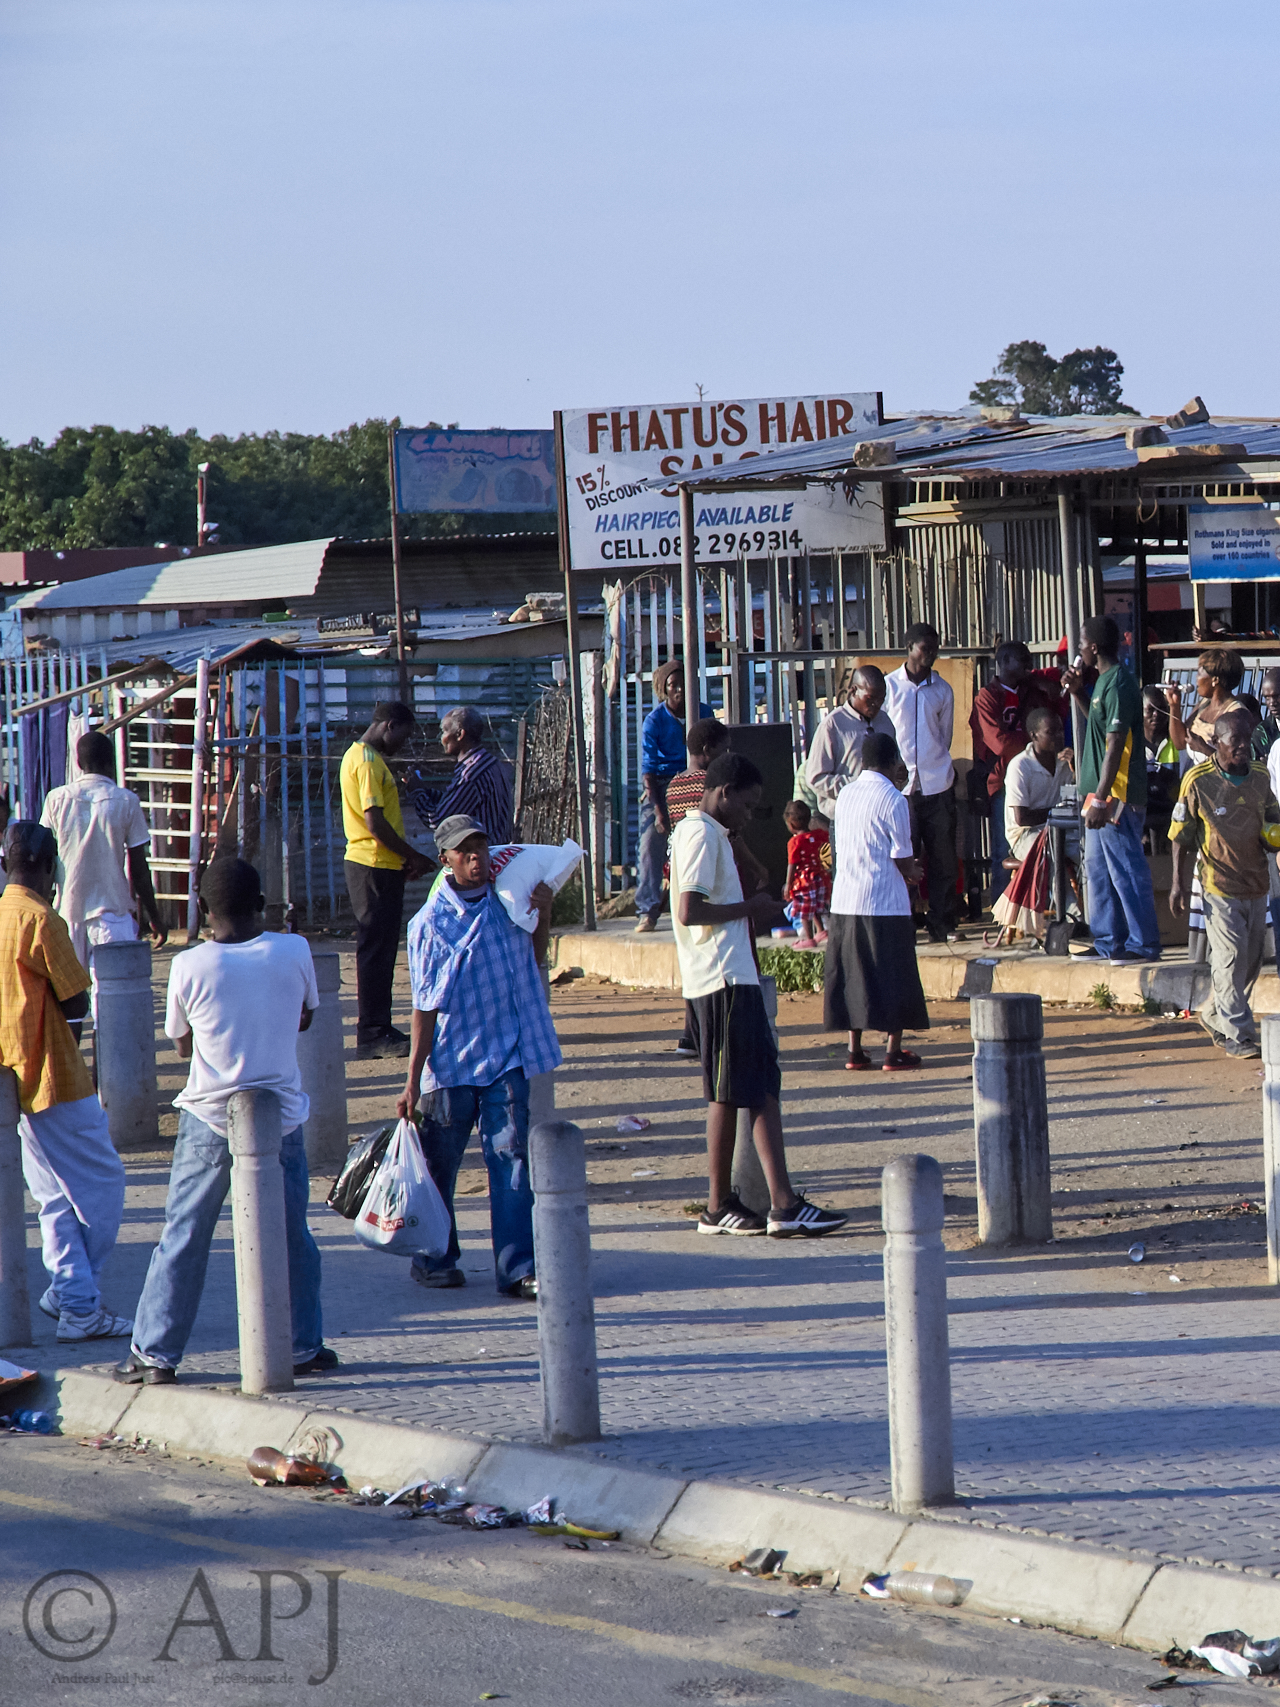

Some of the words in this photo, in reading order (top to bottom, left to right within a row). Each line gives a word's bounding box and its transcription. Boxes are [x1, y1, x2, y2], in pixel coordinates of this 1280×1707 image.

[587, 403, 747, 453] FHATU'S
[758, 399, 858, 444] HAIR
[575, 464, 611, 495] 15%
[594, 510, 681, 533] HAIRPIEC
[696, 502, 794, 527] AVAILABLE
[708, 529, 803, 555] 2969314
[1195, 530, 1224, 538] Rothmans
[1226, 529, 1239, 538] King
[1242, 528, 1254, 536] Size
[1211, 540, 1224, 549] Sold
[1226, 540, 1237, 548] and
[1239, 539, 1263, 549] enjoyed
[1264, 539, 1271, 547] in
[1241, 551, 1270, 559] countries
